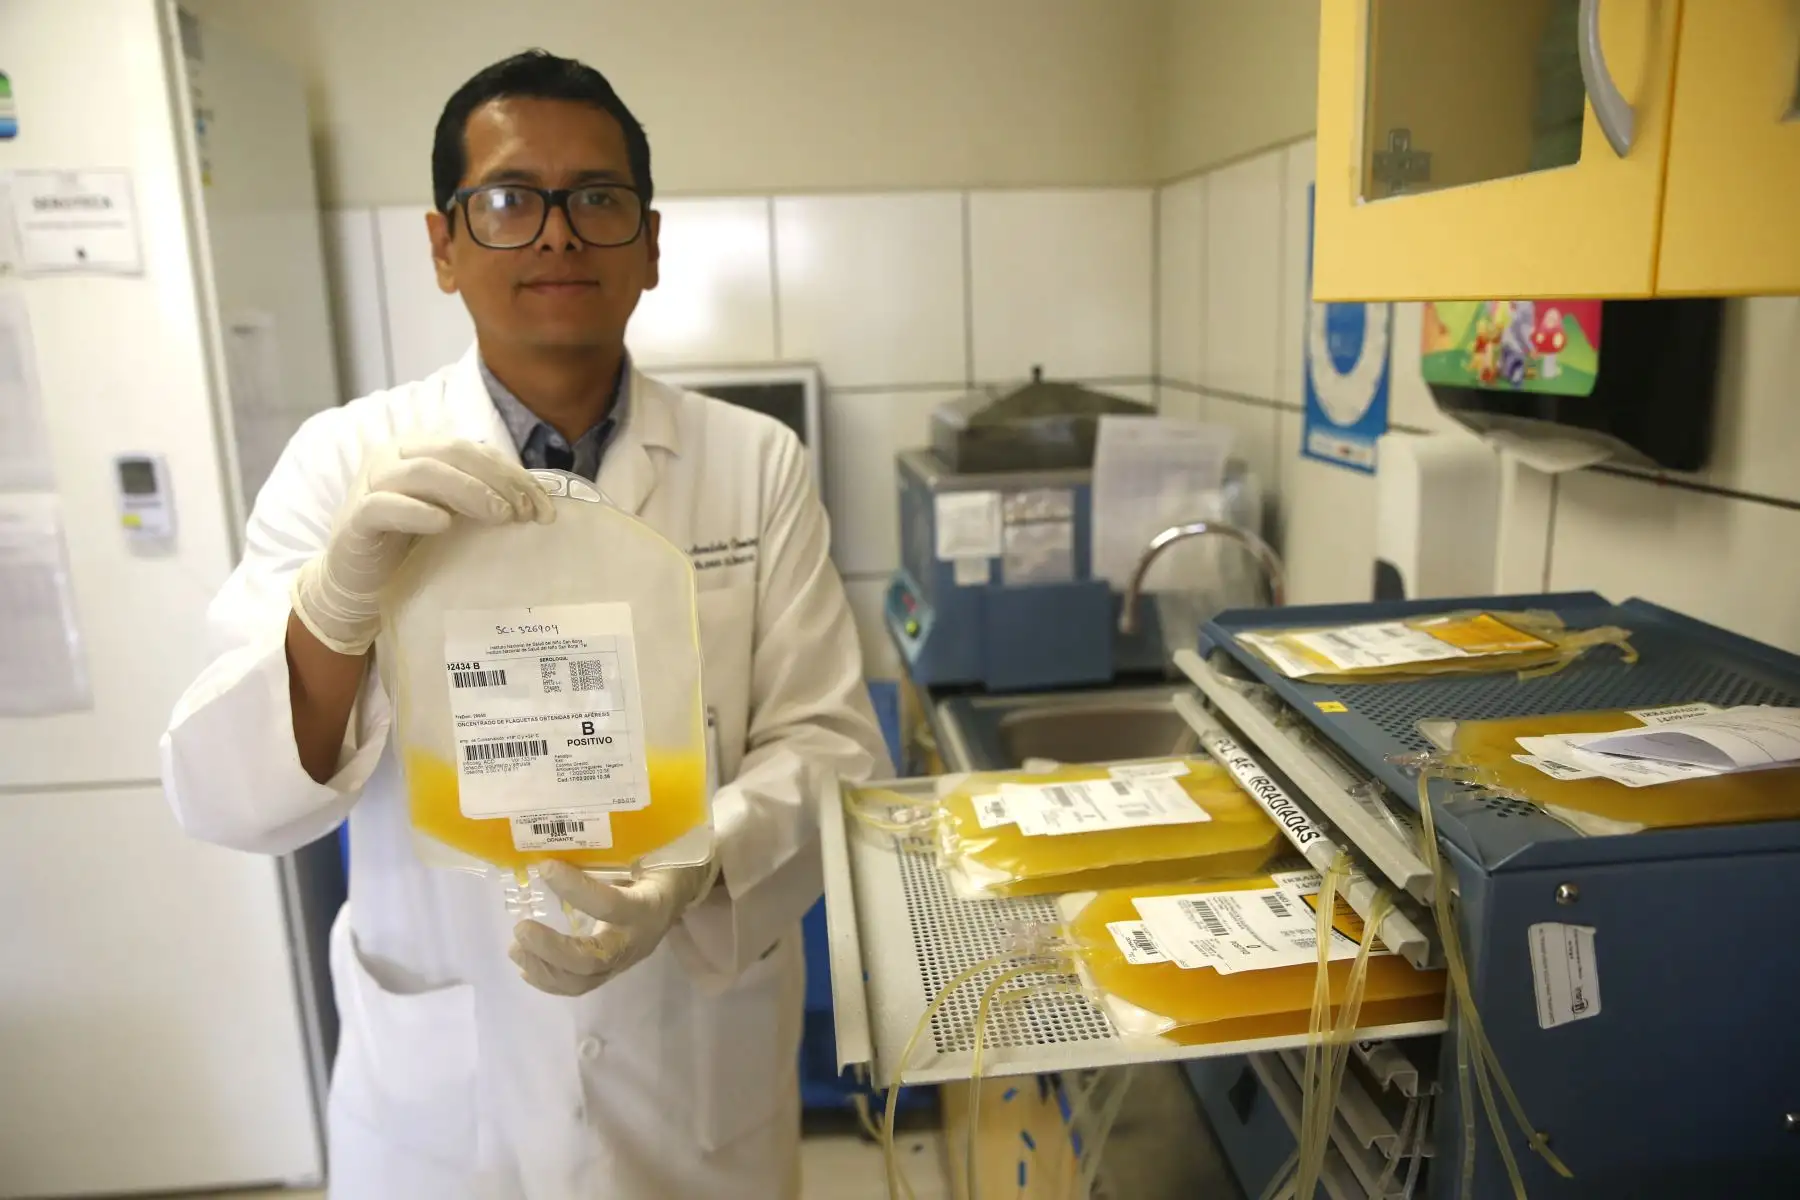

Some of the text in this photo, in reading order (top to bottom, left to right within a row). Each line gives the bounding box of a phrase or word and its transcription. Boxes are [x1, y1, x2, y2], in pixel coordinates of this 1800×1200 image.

[473, 662, 480, 670] B
[505, 716, 539, 725] PLAQUETAS
[539, 713, 571, 721] OBTENIDAS
[581, 721, 595, 736] B
[567, 736, 613, 747] POSITIVO
[1248, 775, 1321, 844] IRRADIADAS
